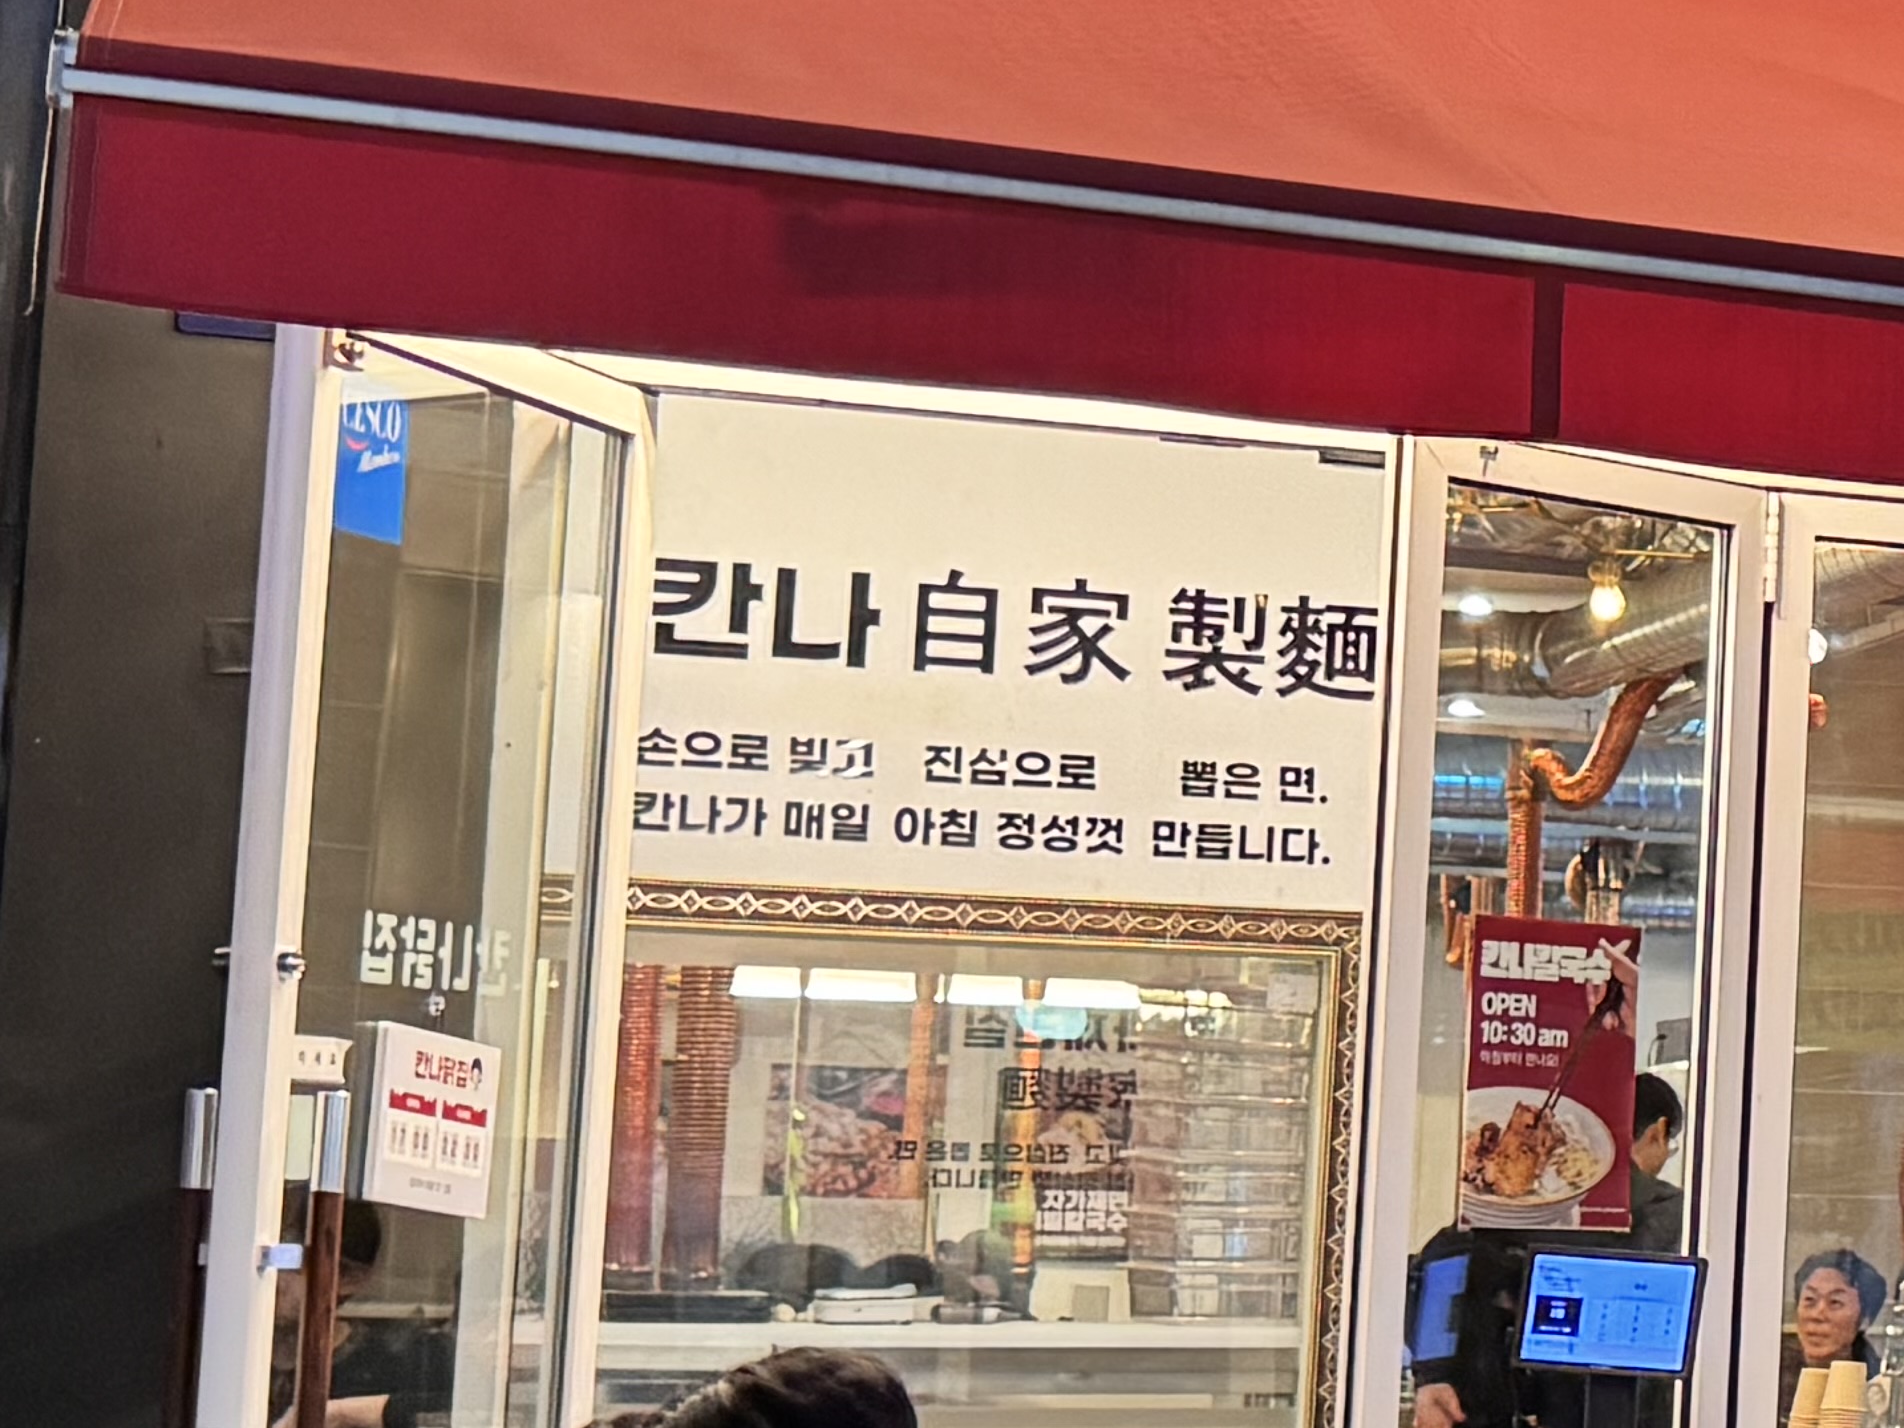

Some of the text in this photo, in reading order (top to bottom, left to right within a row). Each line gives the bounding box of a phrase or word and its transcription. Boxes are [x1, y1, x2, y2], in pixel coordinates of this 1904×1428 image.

[653, 558, 880, 667] 칸나
[637, 728, 769, 771] 손으로
[924, 745, 1096, 790] 진심으로
[1180, 760, 1261, 800] 뽑은
[1279, 766, 1328, 804] 면.
[633, 791, 1330, 865] 칸나가 매일 아침 정성껏 만듭니다.
[1481, 991, 1537, 1018] OPEN
